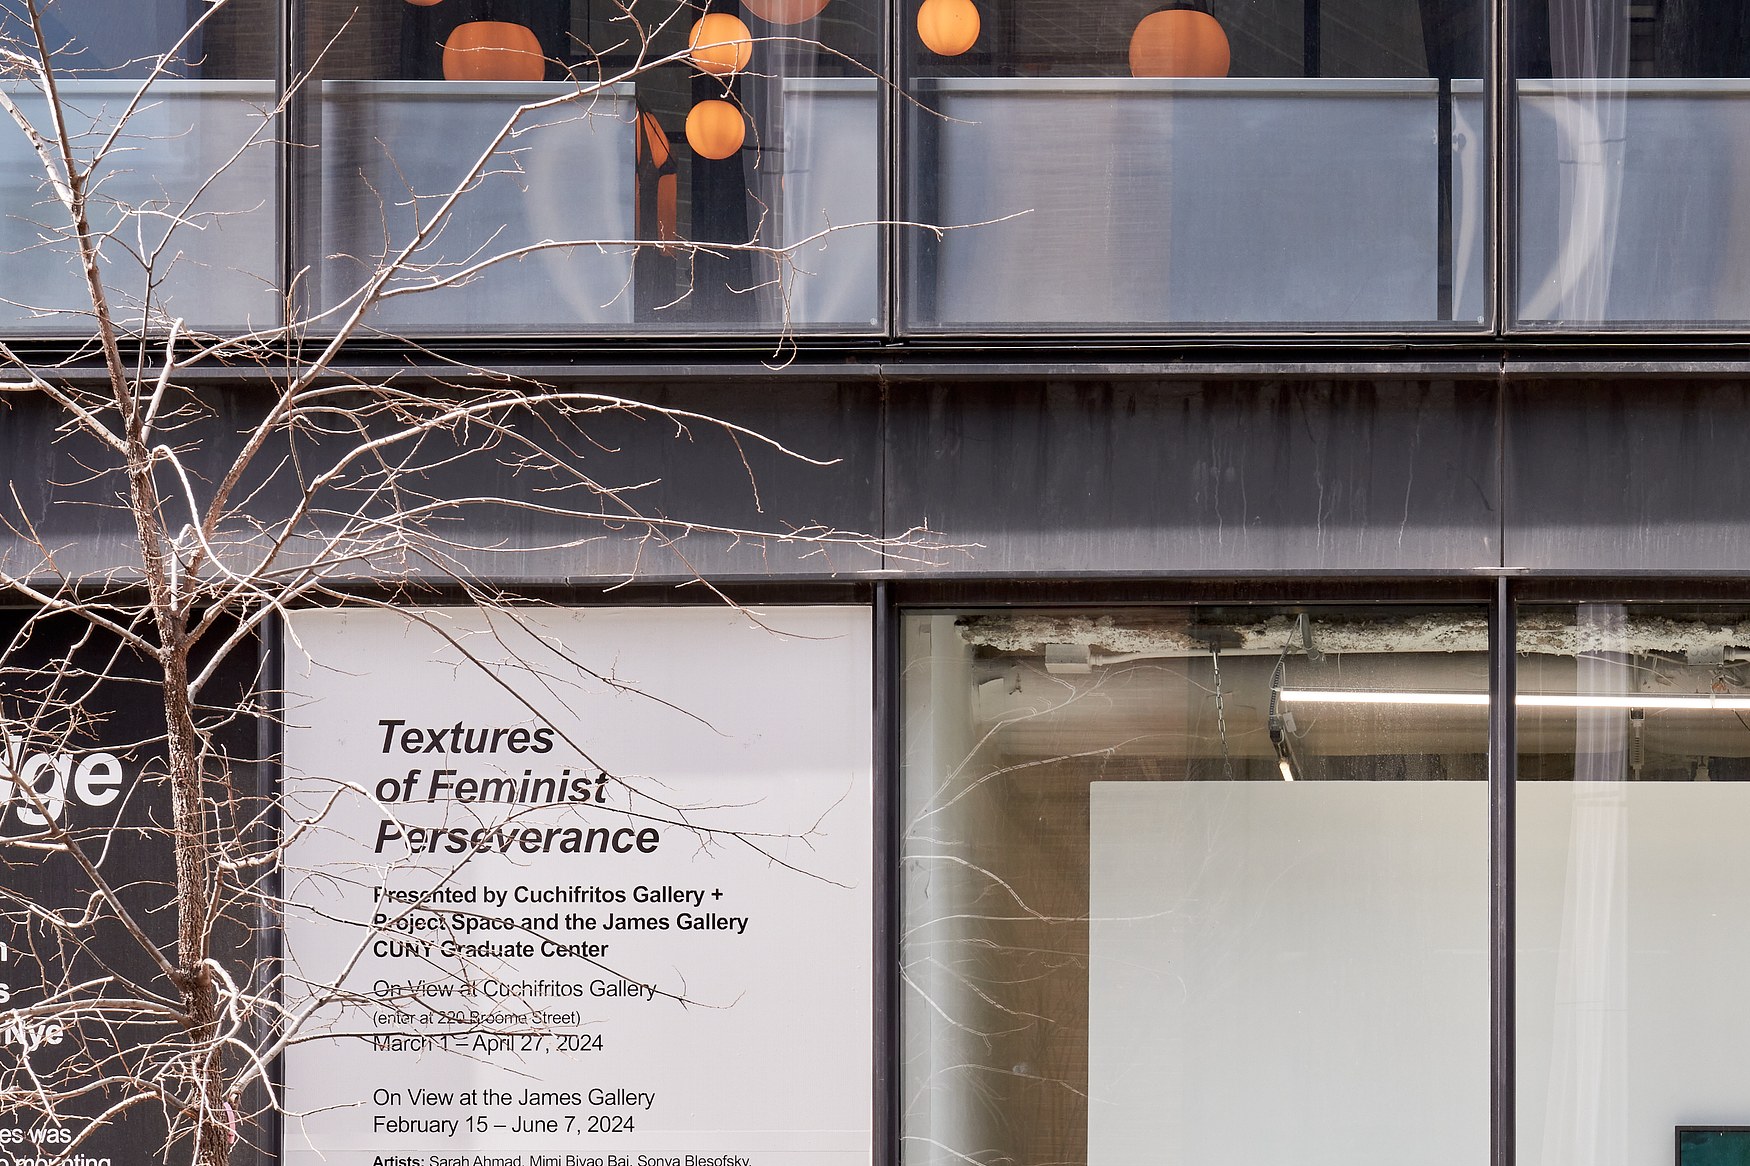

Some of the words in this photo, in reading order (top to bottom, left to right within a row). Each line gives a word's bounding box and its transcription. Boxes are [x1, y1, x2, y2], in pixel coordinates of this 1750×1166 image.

[378, 719, 555, 754] Textures
[374, 769, 422, 804] of
[427, 769, 609, 804] Feminist
[374, 819, 660, 854] Perseverance
[373, 885, 477, 903] Presented
[483, 885, 509, 907] by
[514, 885, 627, 903] Cuchifritos
[632, 885, 706, 907] Gallery
[710, 888, 724, 901] +
[373, 913, 446, 934] Project
[451, 913, 515, 934] Space
[520, 913, 559, 930] and
[564, 913, 597, 930] the
[602, 913, 670, 930] James
[675, 913, 749, 934] Gallery
[373, 940, 432, 958] CUNY
[440, 940, 535, 958] Graduate
[540, 940, 609, 958] Center
[373, 980, 401, 998] On
[407, 980, 454, 998] View
[459, 982, 478, 998] at
[483, 980, 584, 998] Cuchifritos
[589, 980, 657, 1001] Gallery
[373, 1011, 416, 1028] (enter
[420, 1012, 434, 1025] at
[437, 1011, 465, 1025] 220
[469, 1011, 527, 1025] Broome
[531, 1011, 581, 1028] Street)
[373, 1034, 433, 1052] March
[472, 1034, 515, 1056] April
[520, 1034, 550, 1054] 27,
[556, 1034, 604, 1052] 2024
[373, 1088, 401, 1106] On
[407, 1088, 454, 1106] View
[459, 1089, 478, 1106] at
[482, 1088, 513, 1106] the
[518, 1088, 582, 1106] James
[588, 1088, 656, 1111] Gallery
[374, 1115, 459, 1138] February
[465, 1115, 488, 1133] 15
[511, 1115, 558, 1133] June
[564, 1115, 581, 1136] 7,
[587, 1115, 635, 1133] 2024
